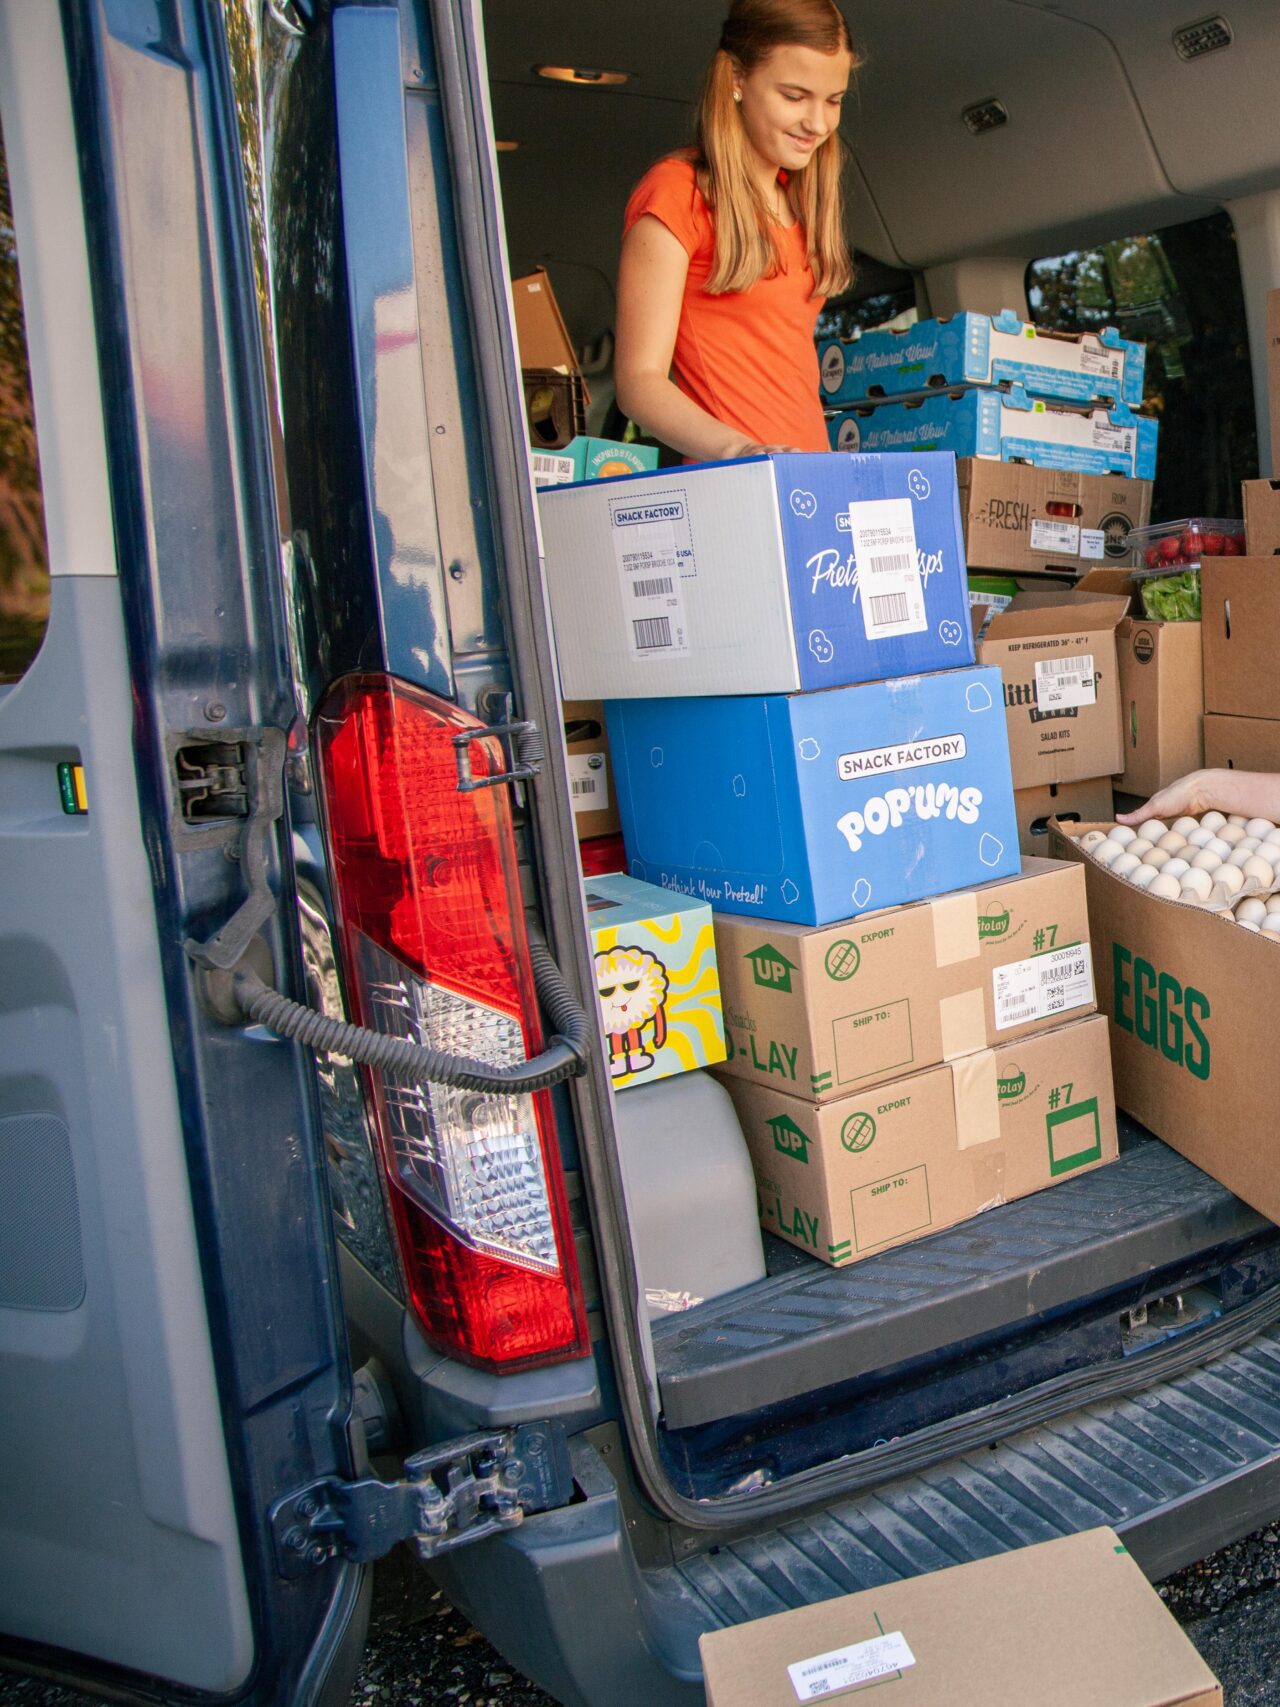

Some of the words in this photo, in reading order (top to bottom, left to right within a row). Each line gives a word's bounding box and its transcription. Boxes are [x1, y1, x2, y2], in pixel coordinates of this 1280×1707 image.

[847, 355, 864, 374] All
[866, 349, 904, 372] Natural
[906, 340, 938, 362] Wow!
[862, 431, 879, 449] All
[880, 427, 919, 447] Natural
[918, 421, 951, 440] Wow!
[617, 510, 643, 522] SNACK
[644, 506, 680, 519] FACTORY
[988, 498, 1029, 531] FRESH
[806, 548, 859, 604] Pretz
[1008, 644, 1021, 652] KEEP
[1022, 640, 1060, 650] REFRIGERATED
[1003, 679, 1038, 708] littl
[1040, 731, 1057, 741] SALAD
[1059, 730, 1070, 739] KITS
[844, 753, 893, 774] SNACK
[897, 740, 960, 764] FACTORY
[661, 872, 696, 896] Rethink
[698, 879, 721, 903] Your
[724, 881, 764, 905] Pretzel!
[860, 927, 895, 944] EXPORT
[1033, 924, 1058, 951] #7
[756, 957, 786, 983] UP
[852, 1015, 873, 1028] SHIP
[875, 1011, 891, 1022] TO:
[1112, 941, 1211, 1081] EGGS
[877, 1096, 912, 1114] EXPORT
[1048, 1082, 1073, 1110] #7
[775, 1125, 802, 1152] UP
[870, 1183, 890, 1197] SHIP
[892, 1178, 908, 1189] TO:
